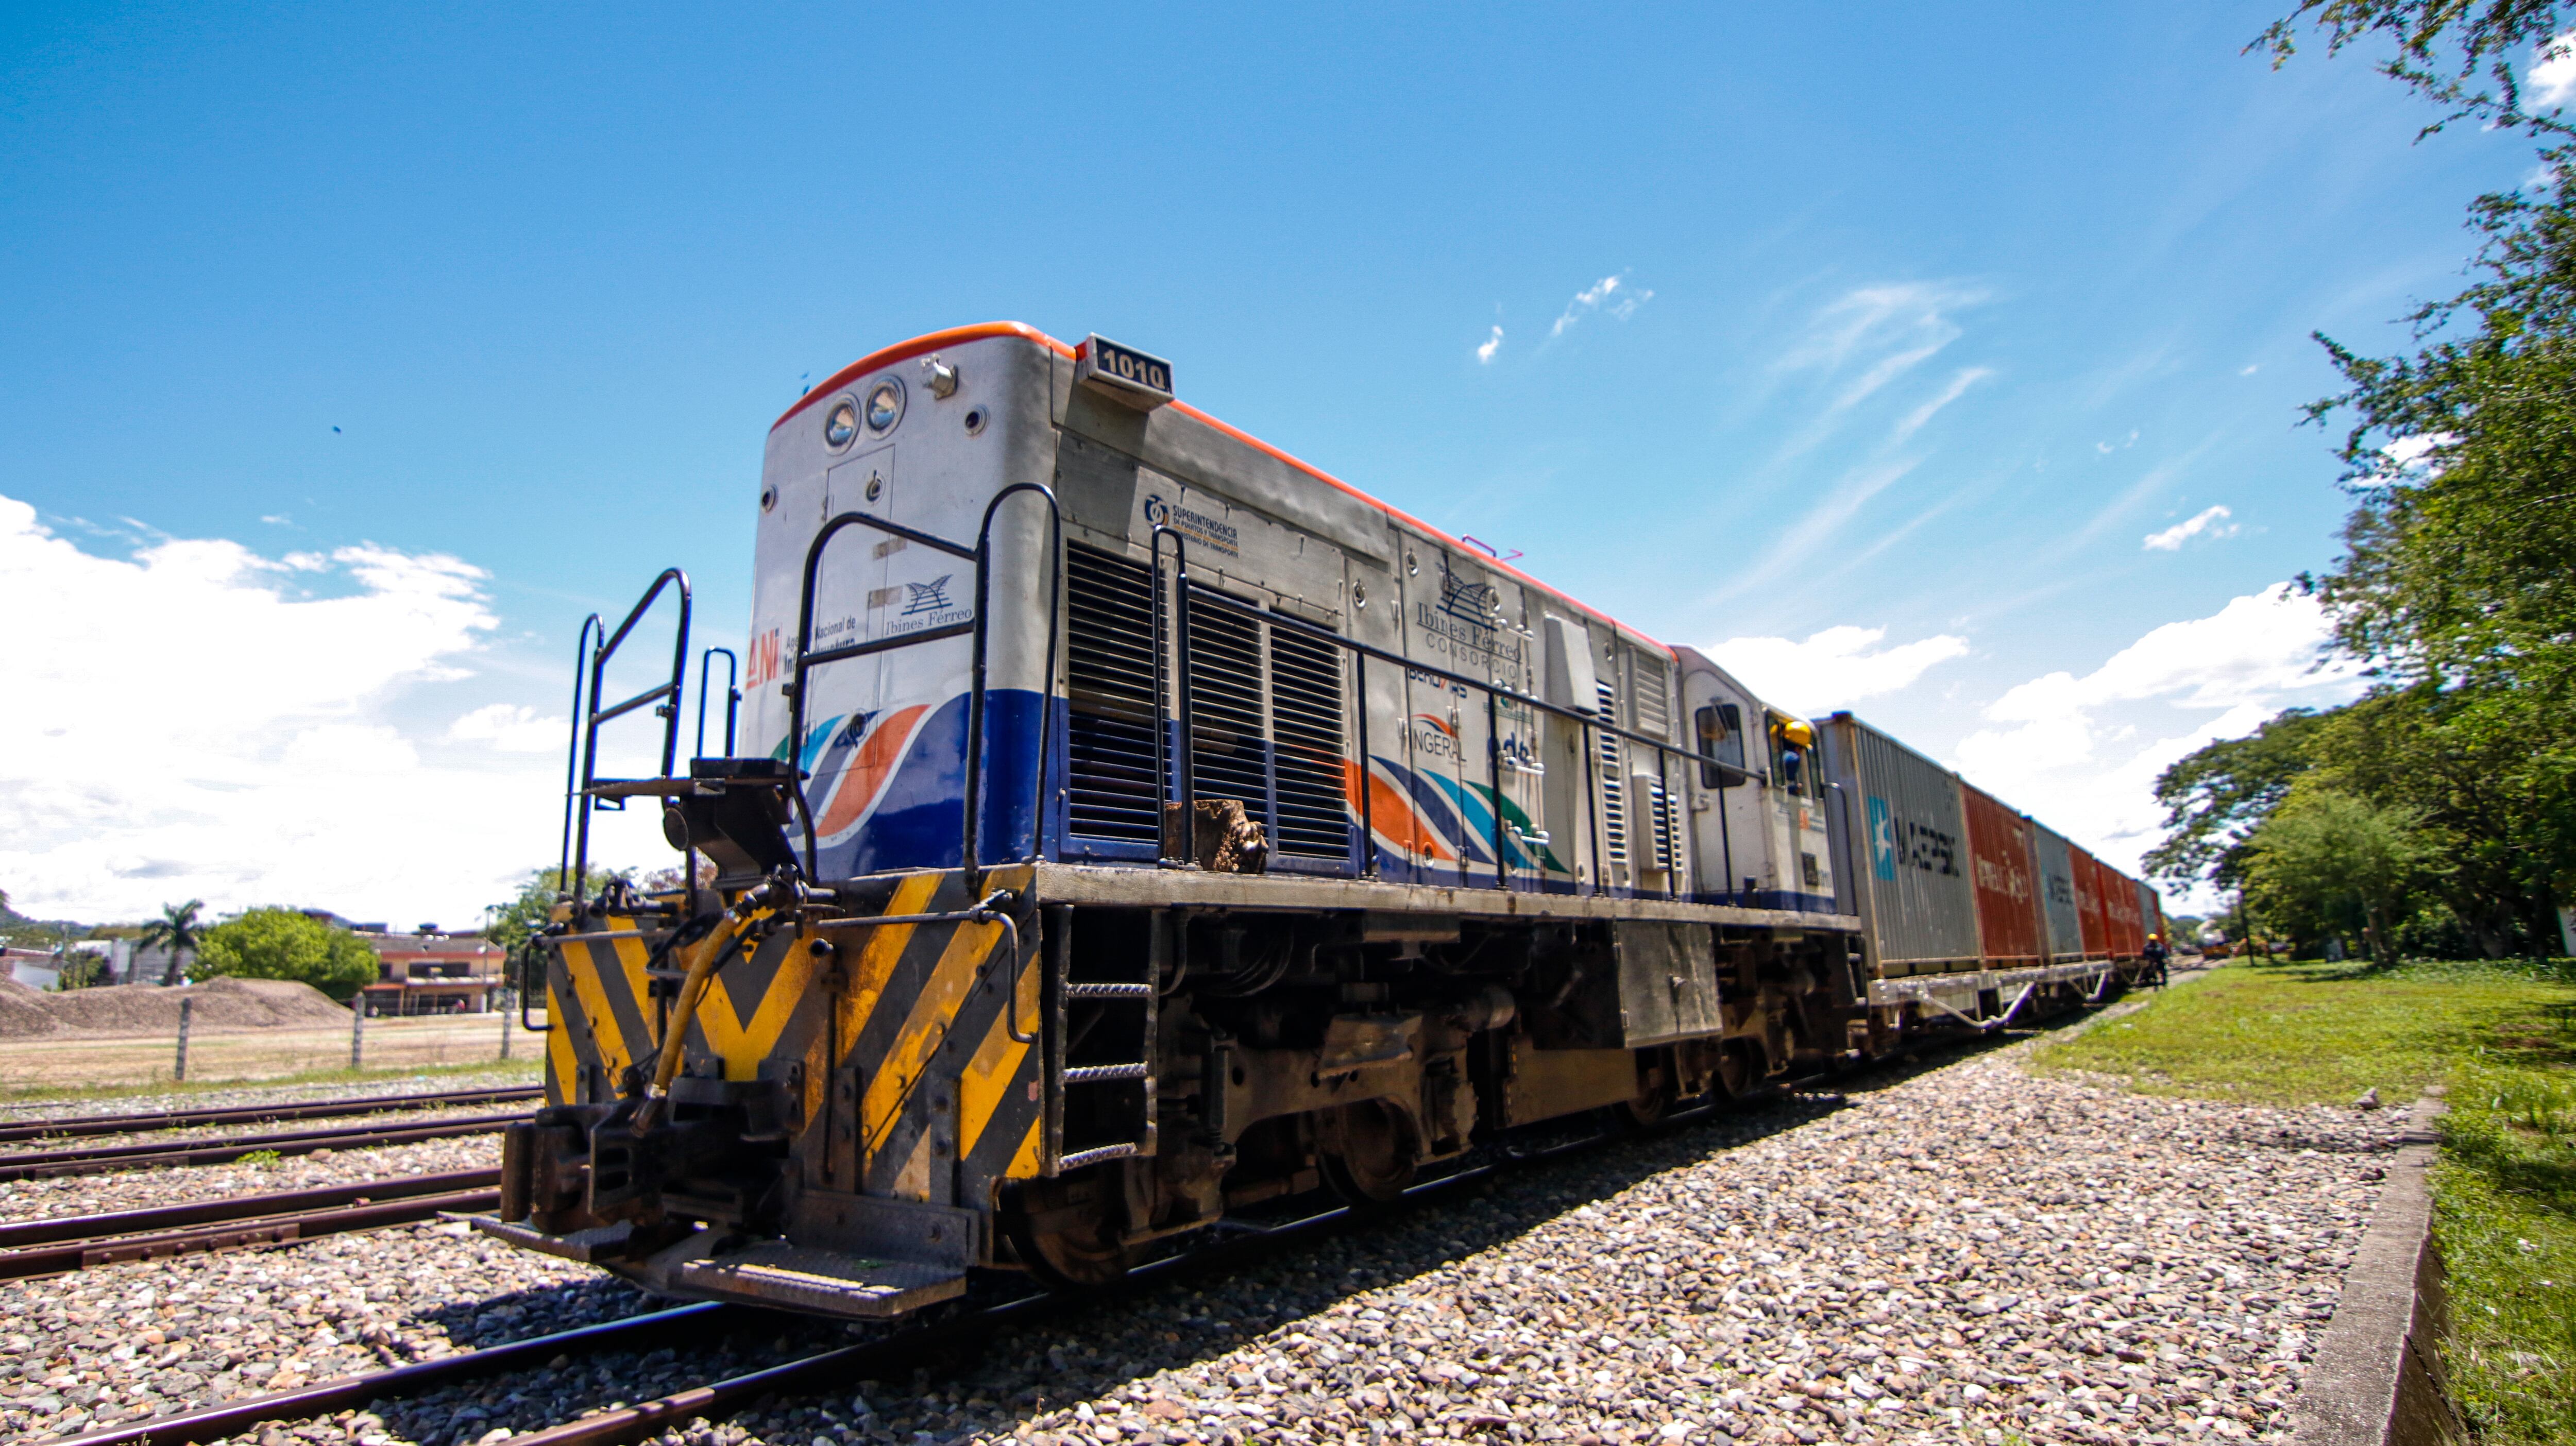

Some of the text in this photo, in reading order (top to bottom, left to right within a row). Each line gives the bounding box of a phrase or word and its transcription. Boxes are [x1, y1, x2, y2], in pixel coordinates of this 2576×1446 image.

[1105, 349, 1165, 389] 1010
[1173, 505, 1238, 539] SUPERINTENDENCIA
[1209, 531, 1238, 548] TRANSPORTE
[847, 614, 856, 630] de
[886, 608, 973, 636] Ibines Férreo
[1418, 601, 1466, 641] Ibines
[1426, 633, 1517, 678] CONSORCIO
